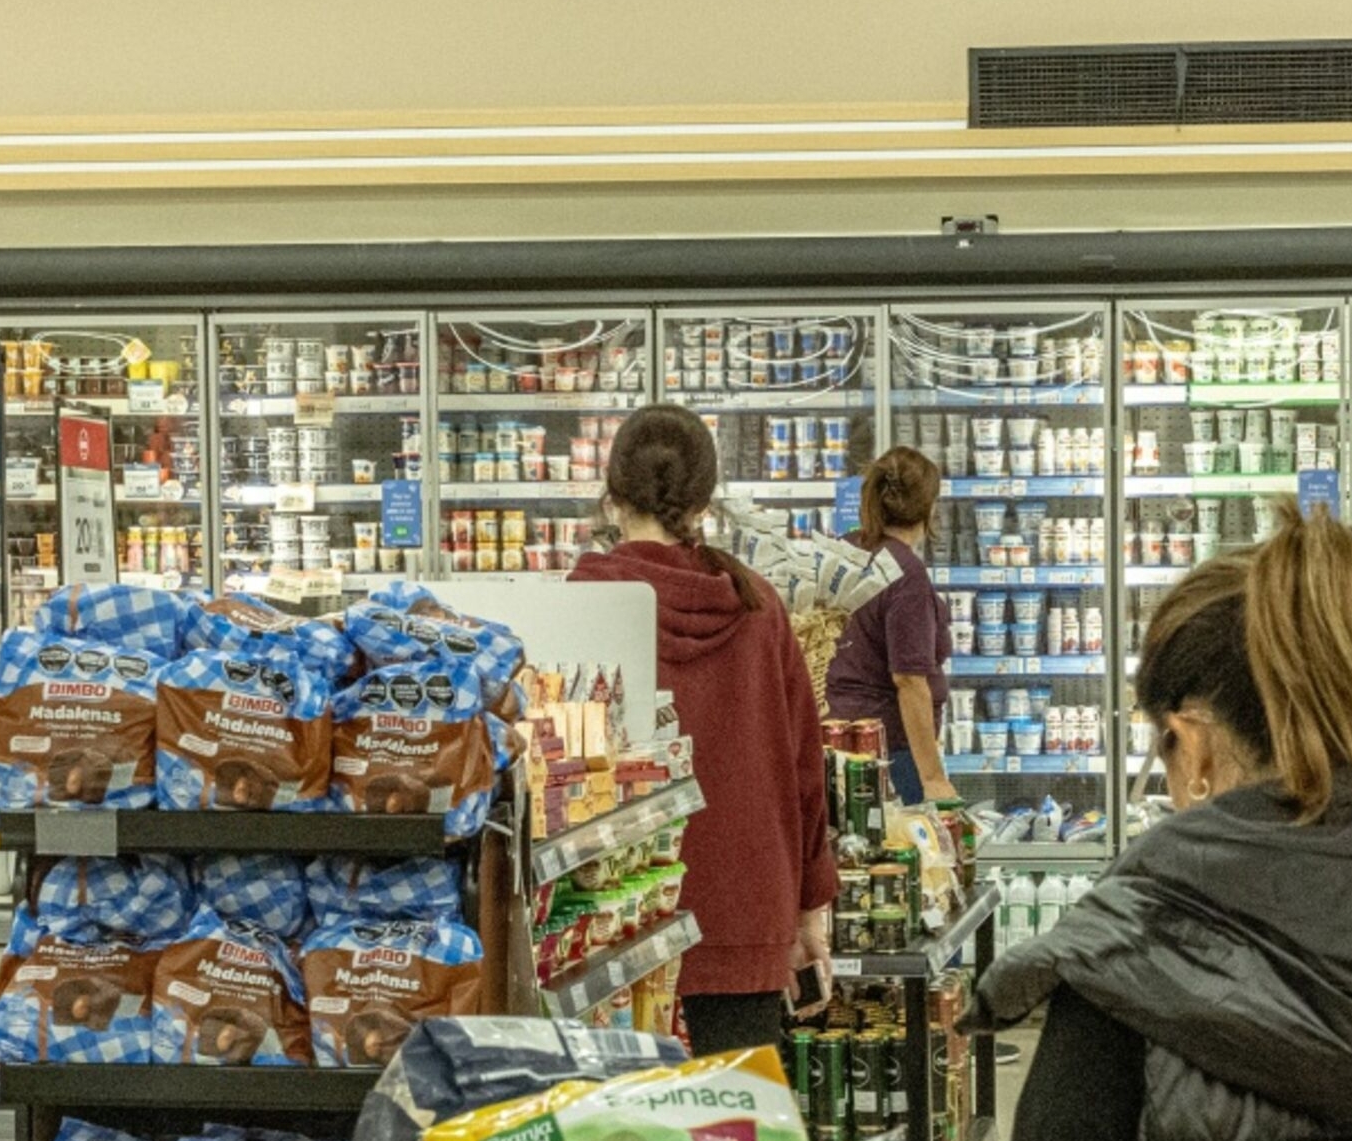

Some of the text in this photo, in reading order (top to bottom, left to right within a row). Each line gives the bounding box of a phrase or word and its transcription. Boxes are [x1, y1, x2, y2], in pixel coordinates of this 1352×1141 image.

[48, 684, 106, 697] BIMBO
[29, 705, 122, 724] Madalenas
[229, 697, 285, 715] BIMBO
[204, 710, 294, 742] Madalenas
[377, 713, 429, 734] BIMBO
[355, 734, 439, 756] Madalenas
[334, 966, 421, 992] Madalenas
